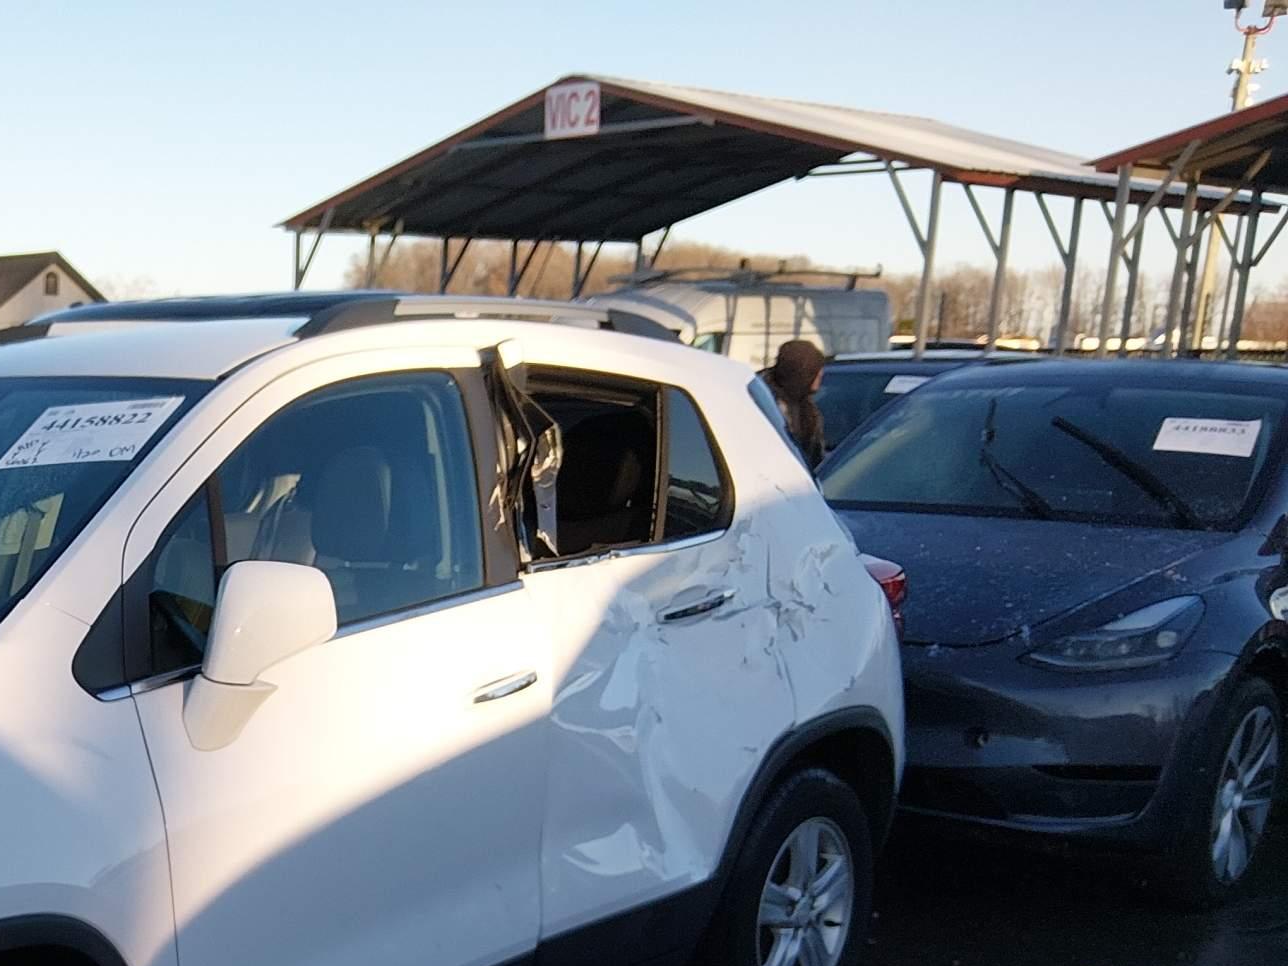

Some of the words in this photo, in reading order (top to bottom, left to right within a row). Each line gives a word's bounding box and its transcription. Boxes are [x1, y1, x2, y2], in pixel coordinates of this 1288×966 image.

[547, 91, 581, 129] VIC
[584, 90, 599, 126] 2
[42, 412, 153, 431] 44158822
